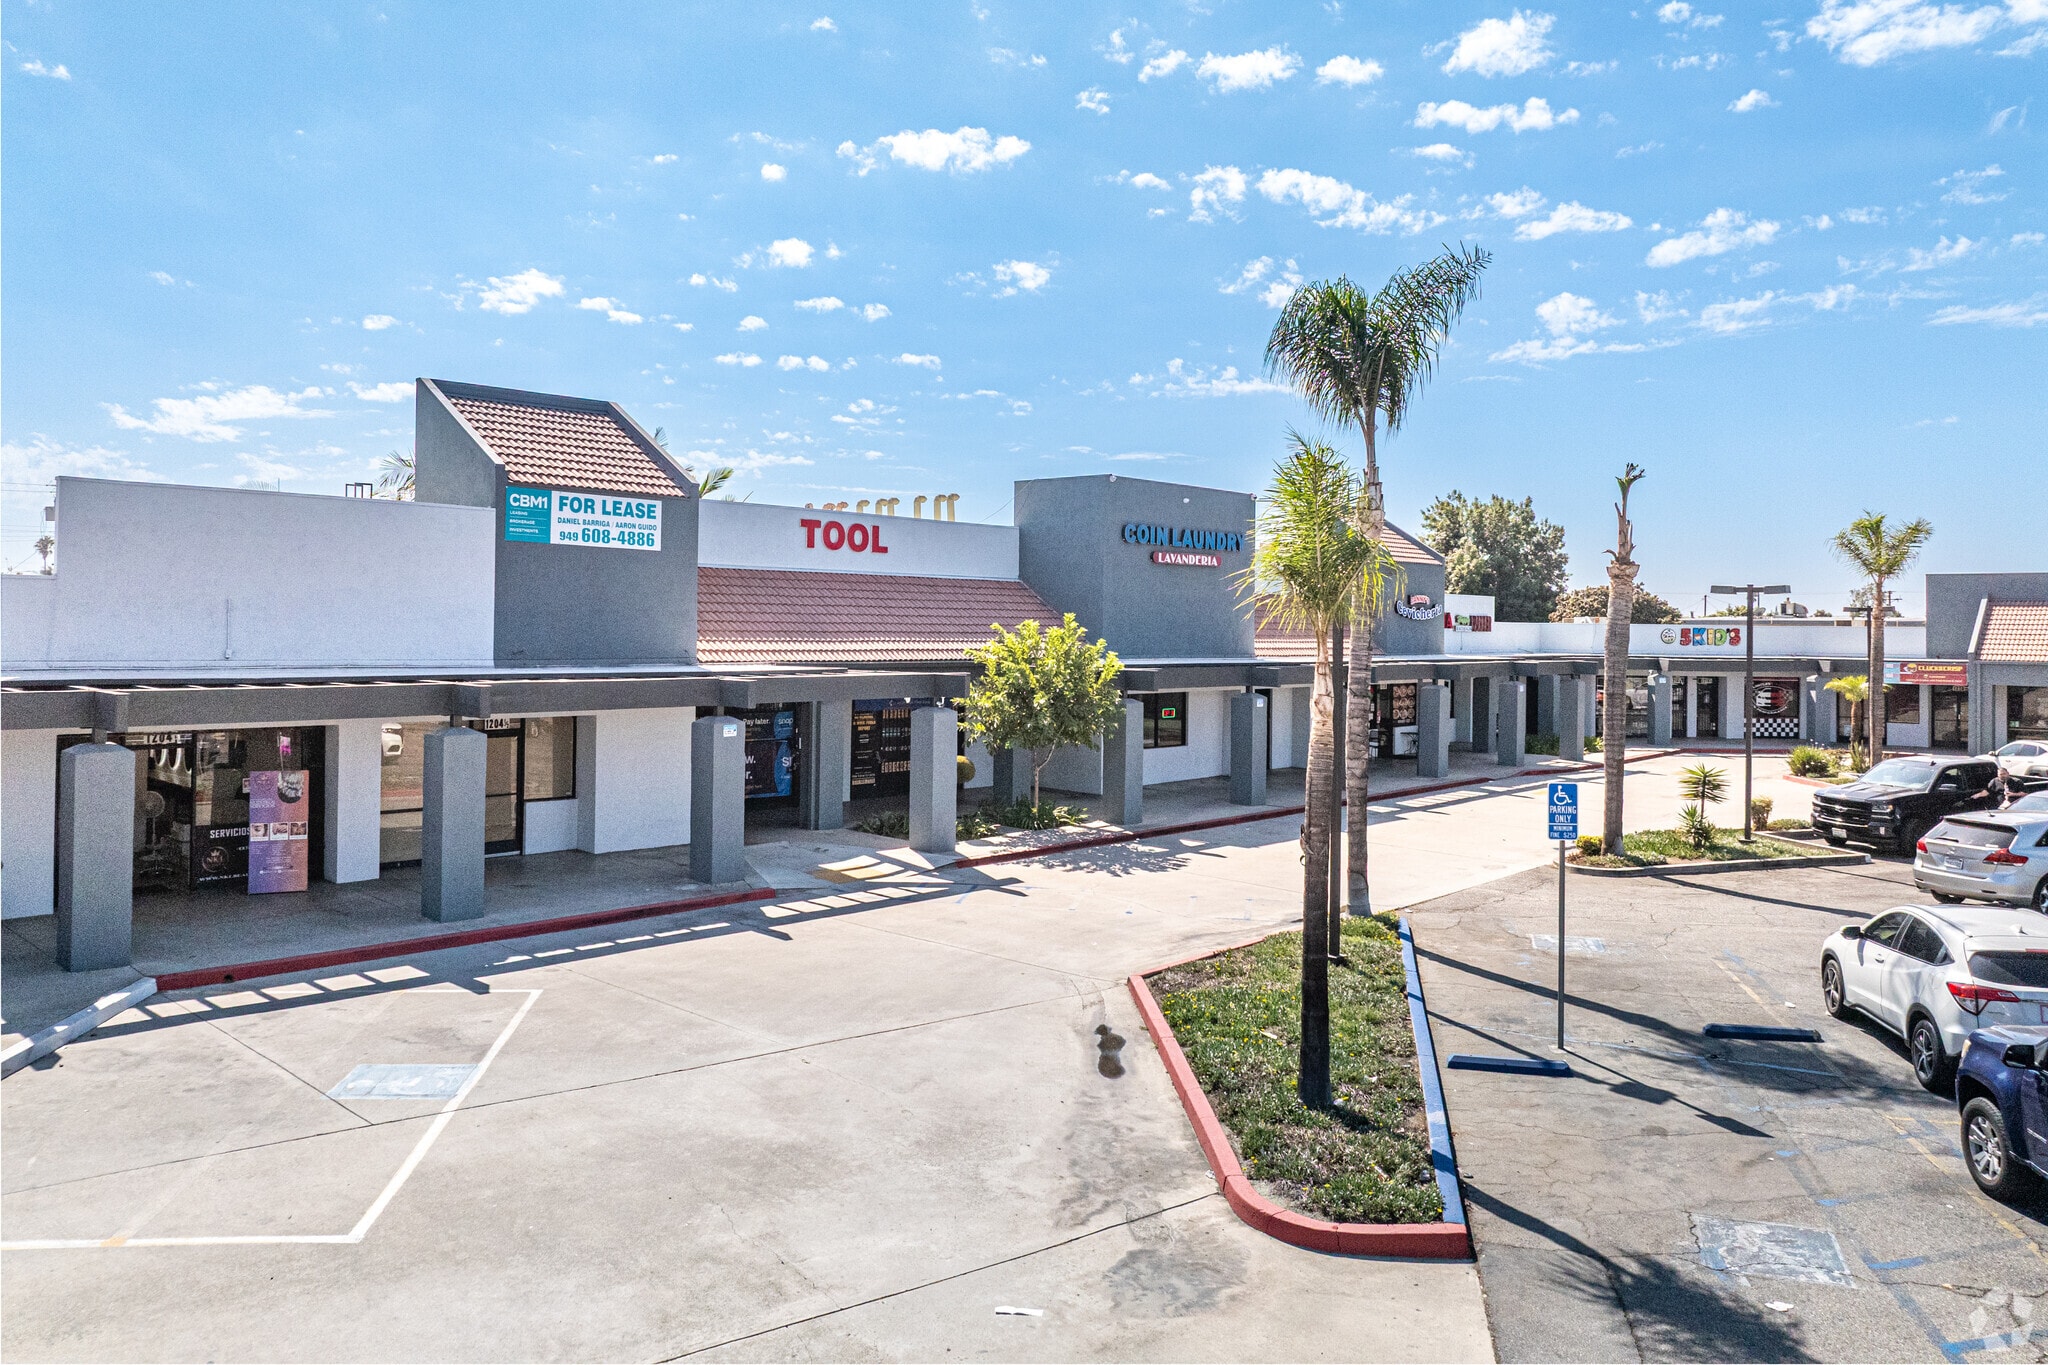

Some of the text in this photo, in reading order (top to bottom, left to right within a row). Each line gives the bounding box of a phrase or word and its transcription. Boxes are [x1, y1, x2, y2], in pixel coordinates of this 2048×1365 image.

[510, 494, 548, 509] CBM1
[558, 496, 657, 519] FOR LEASE
[558, 517, 580, 525] DANIEL
[582, 519, 610, 527] BARRIGA
[638, 523, 657, 531] GUIDO
[560, 528, 655, 547] 949 608-4886
[800, 519, 888, 553] TOOL
[1124, 524, 1244, 551] COIN LAUNDRY
[1158, 552, 1217, 566] LAVANDERIA
[1550, 806, 1576, 814] PARKING
[210, 827, 250, 838] SERVICIOS
